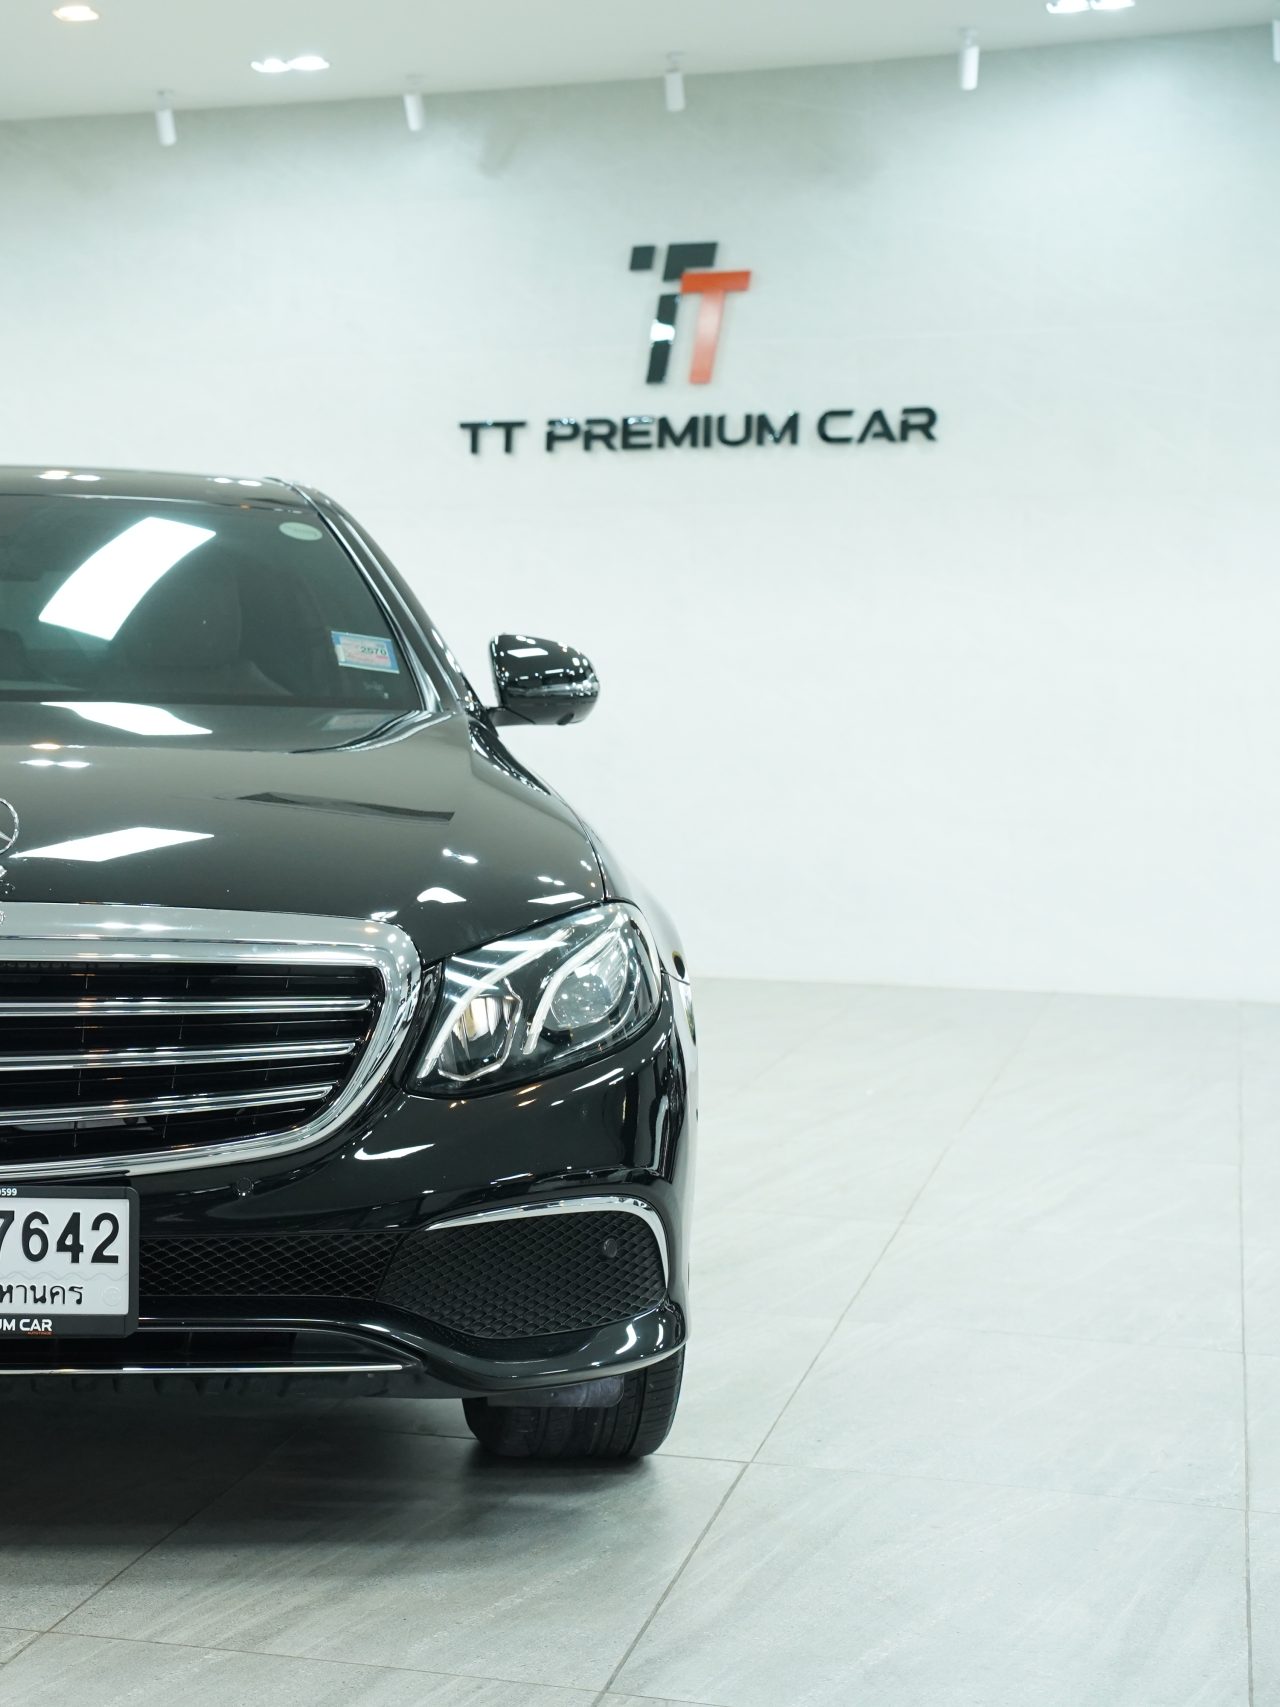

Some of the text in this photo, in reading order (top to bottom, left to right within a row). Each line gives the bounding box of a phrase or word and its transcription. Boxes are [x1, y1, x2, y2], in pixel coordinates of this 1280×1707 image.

[459, 406, 938, 454] TT PREMIUM CAR
[19, 1318, 53, 1332] CAR
